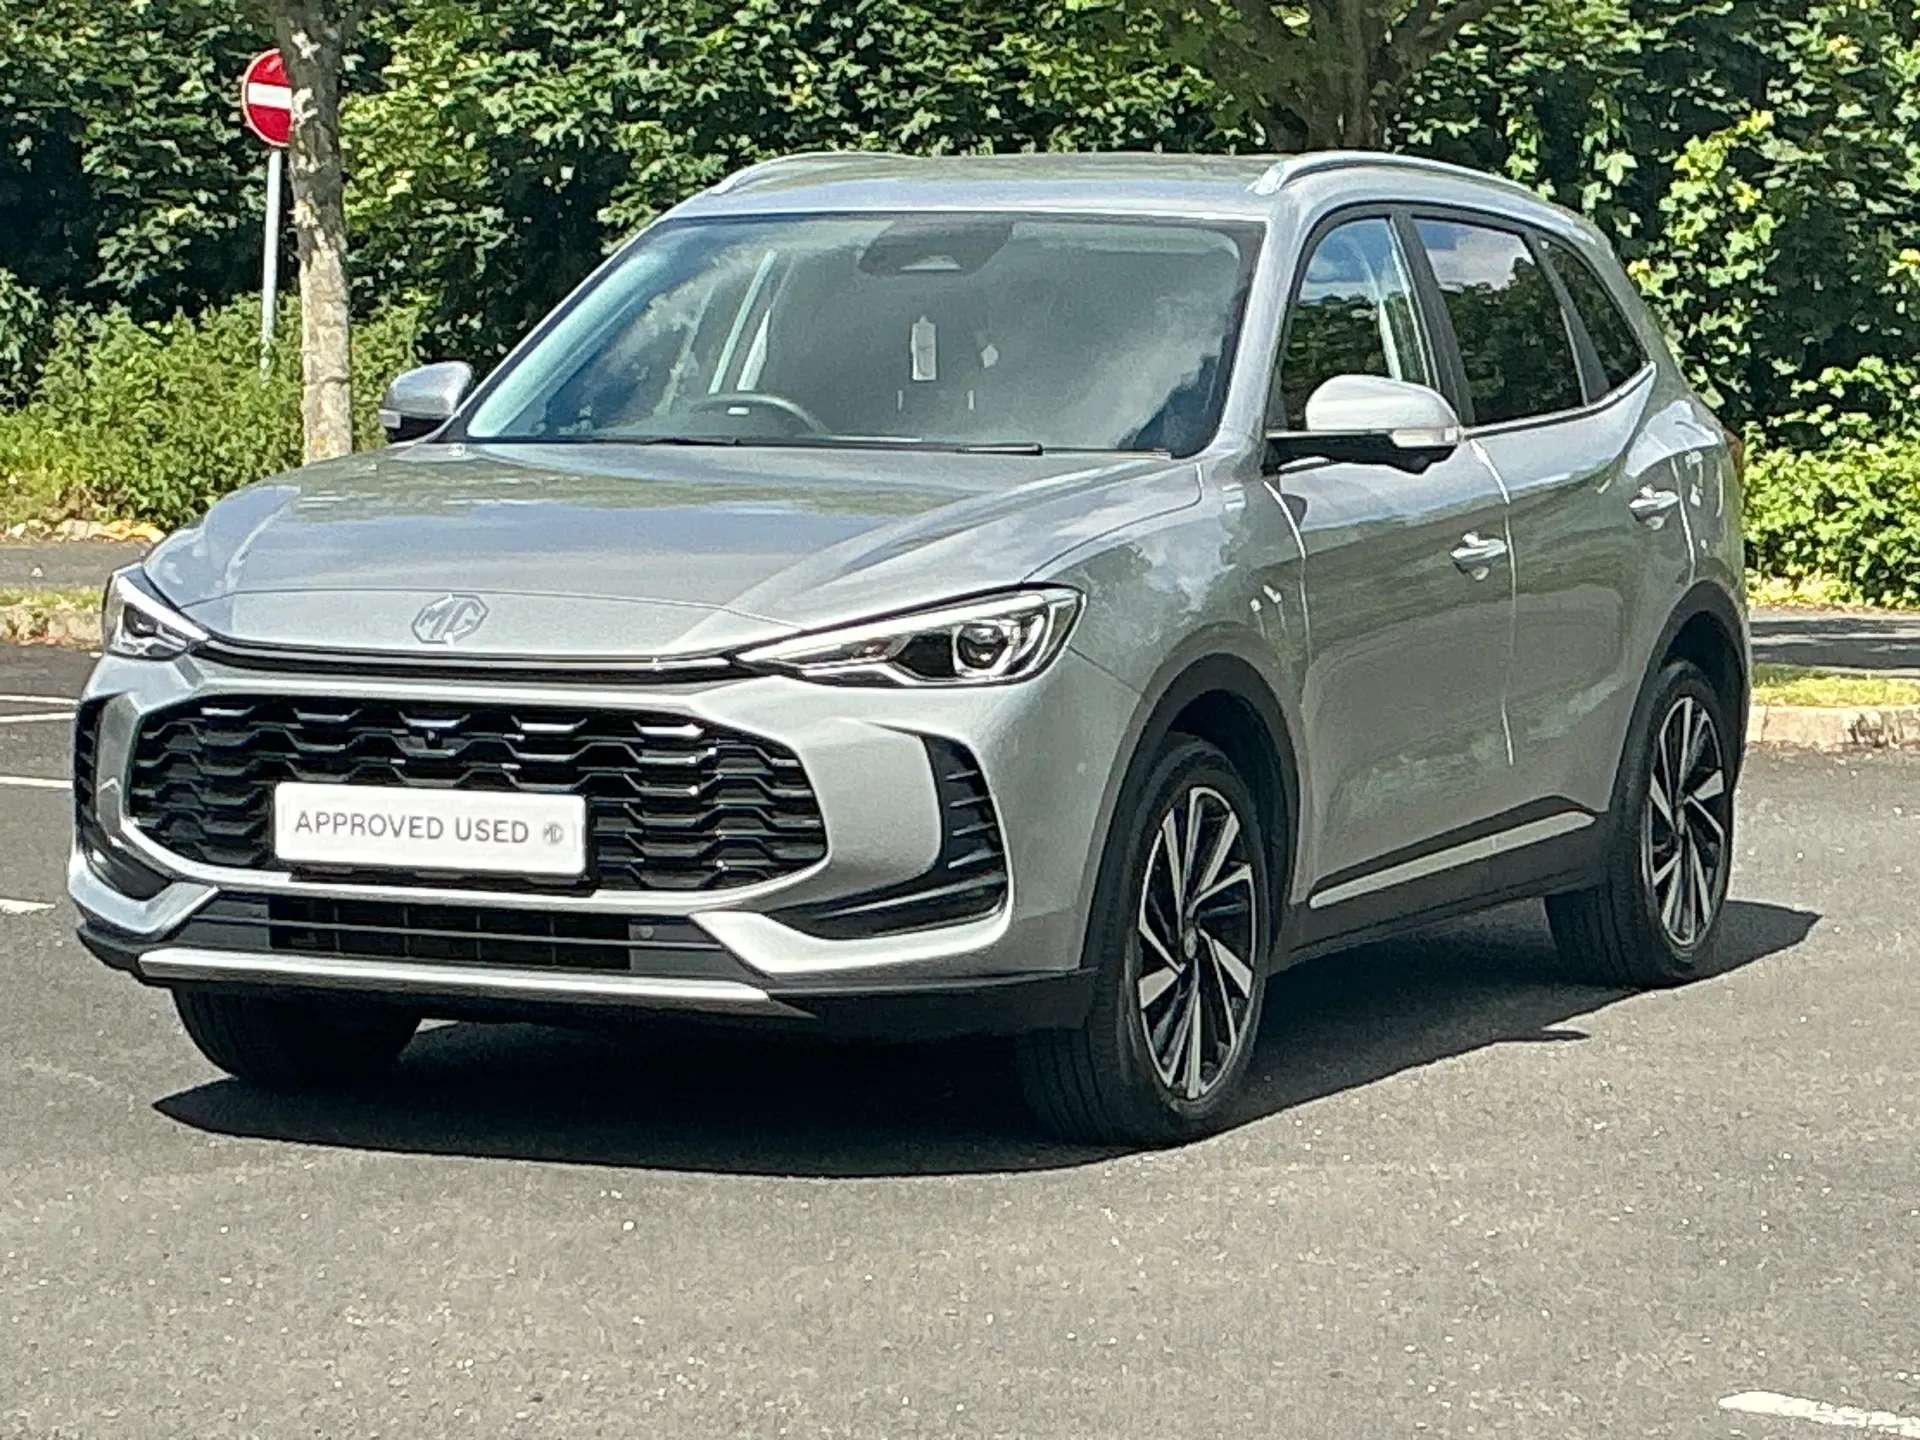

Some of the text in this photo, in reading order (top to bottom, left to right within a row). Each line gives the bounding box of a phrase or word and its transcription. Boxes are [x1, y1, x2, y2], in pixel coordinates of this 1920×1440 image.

[415, 597, 485, 642] MG
[294, 811, 445, 840] APPROVED
[455, 818, 529, 844] USED
